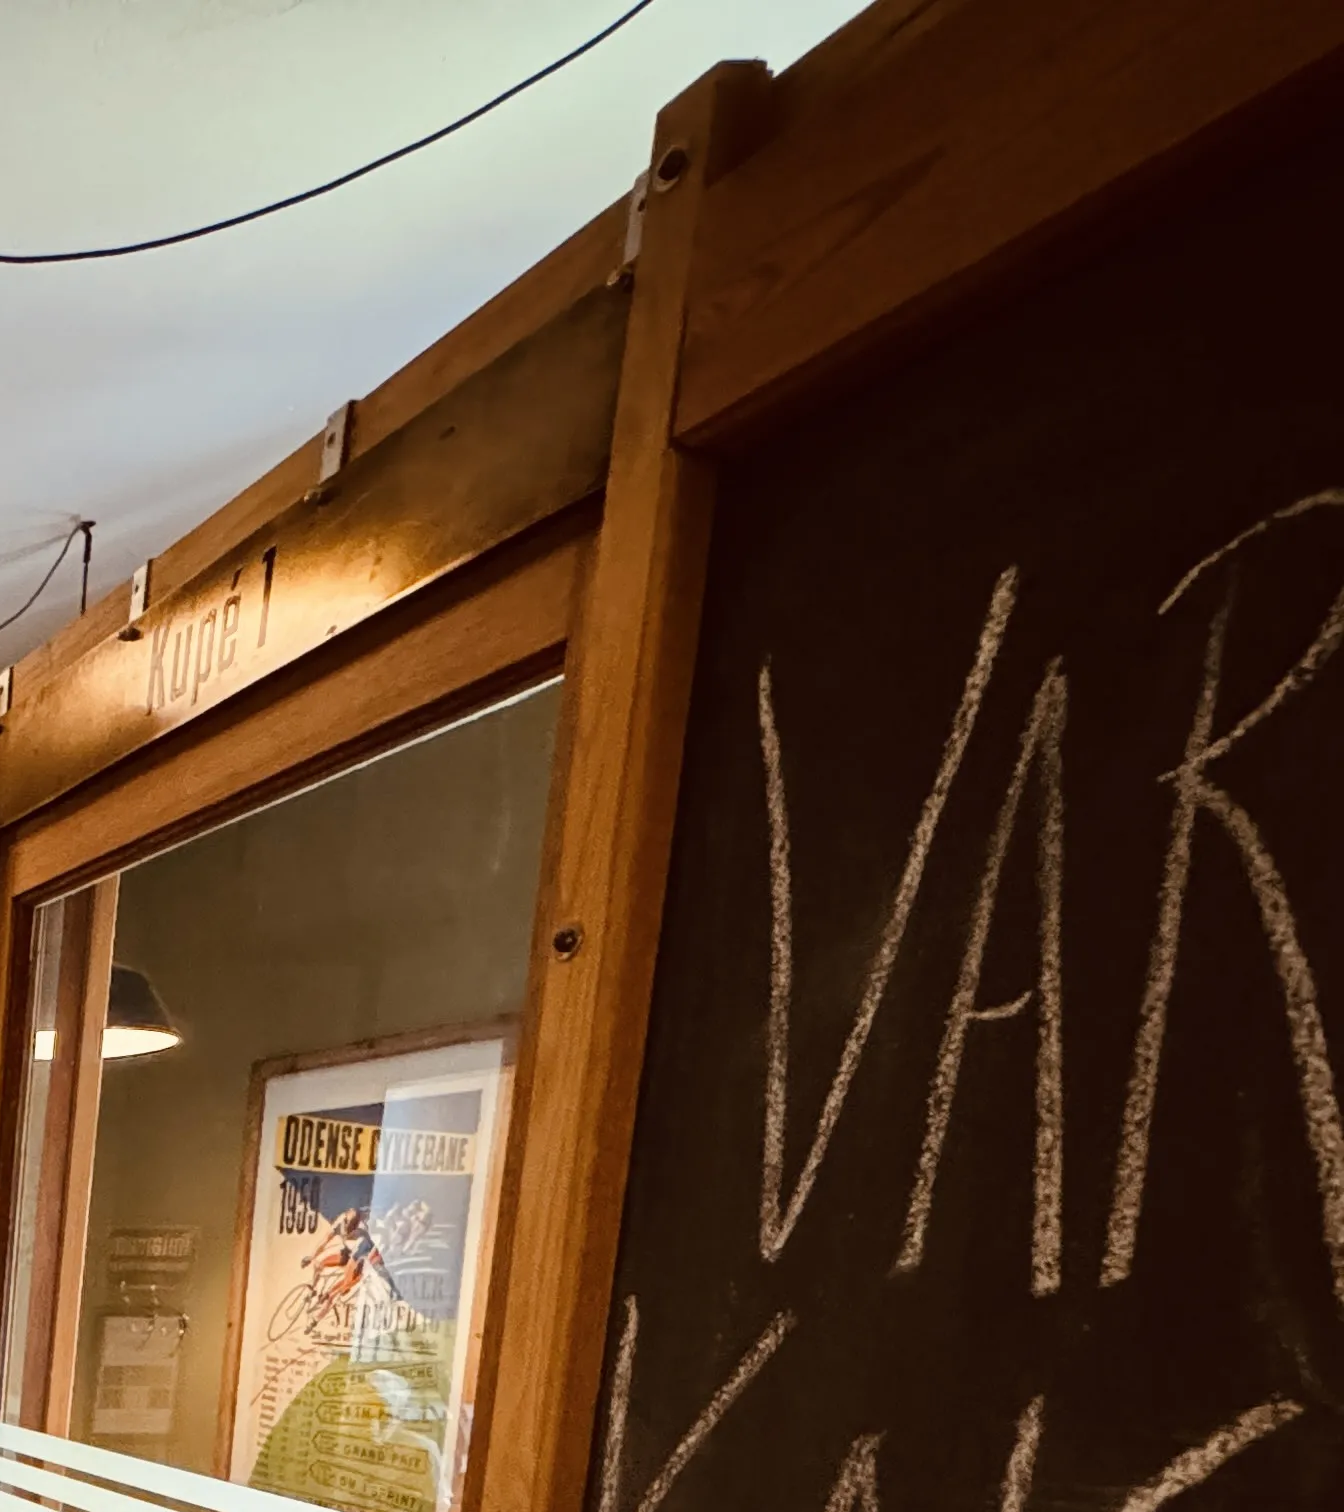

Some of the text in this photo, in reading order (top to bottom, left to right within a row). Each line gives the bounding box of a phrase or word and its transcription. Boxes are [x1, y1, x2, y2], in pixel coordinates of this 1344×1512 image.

[146, 544, 277, 716] Kupé 1
[283, 1114, 469, 1173] ODENSE CYKLEBANE
